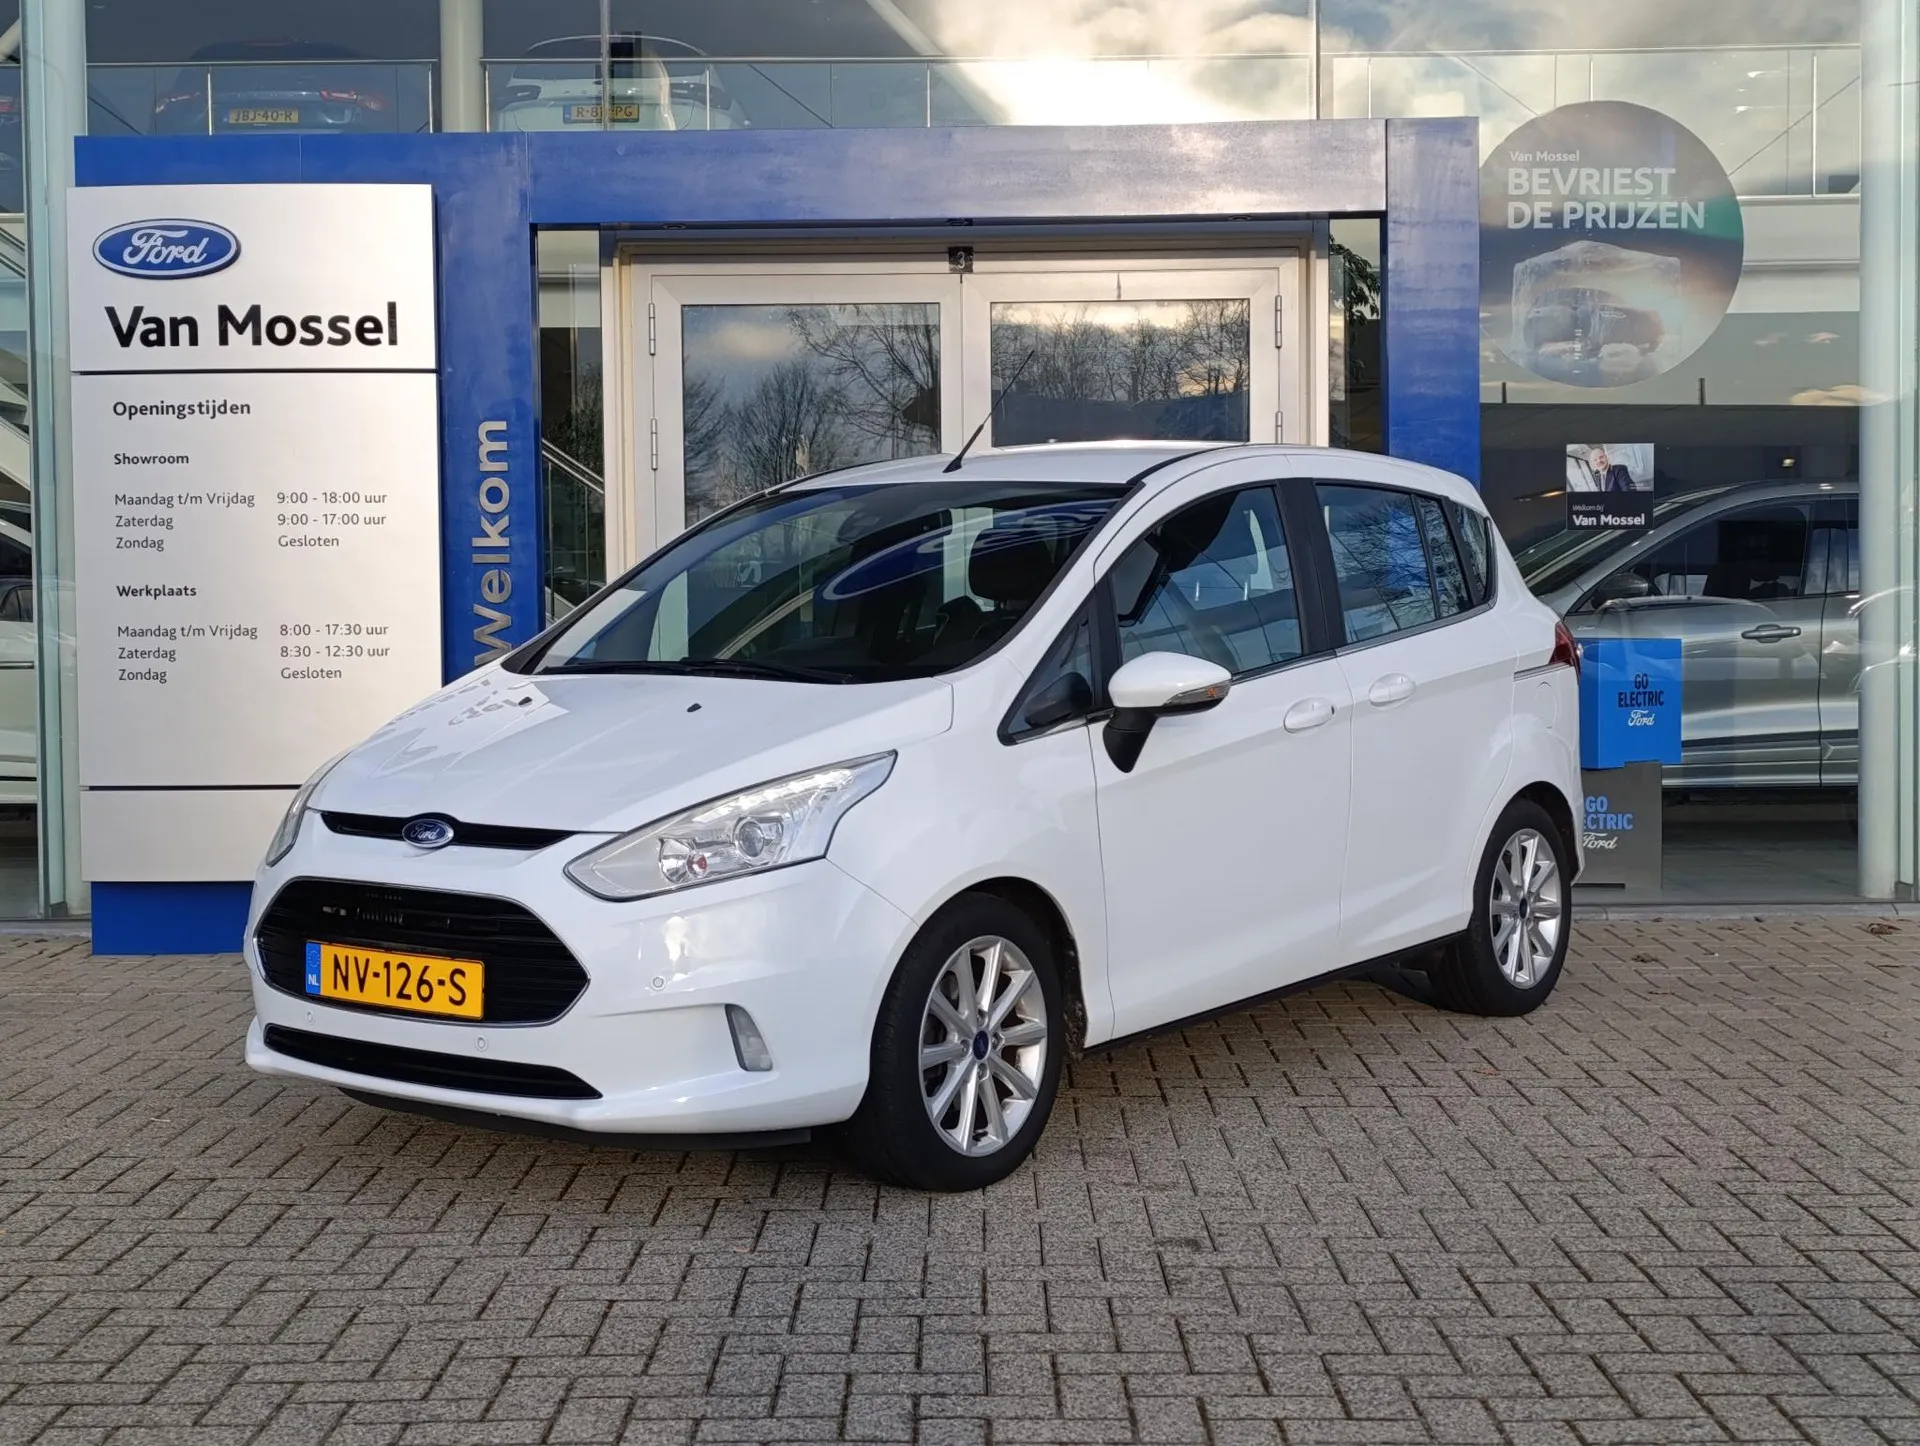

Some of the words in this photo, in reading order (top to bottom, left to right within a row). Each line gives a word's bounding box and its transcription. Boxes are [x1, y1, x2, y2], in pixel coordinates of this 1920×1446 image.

[1509, 151, 1533, 162] Van
[1535, 150, 1580, 162] Mossel
[1507, 167, 1676, 195] BEVRIEST
[1507, 201, 1554, 229] DE
[1563, 201, 1705, 229] PRIJZEN
[122, 226, 210, 265] Ford
[957, 250, 966, 269] 3
[104, 305, 199, 349] Van
[217, 301, 398, 347] Mossel
[112, 399, 251, 420] Openingstijden
[113, 452, 190, 466] Showroom
[114, 492, 175, 508] Maandag
[177, 492, 203, 506] t/m
[205, 491, 256, 508] Vrijdag
[276, 491, 309, 505] 9:00
[321, 491, 361, 504] 18:00
[364, 494, 388, 504] uur
[114, 514, 174, 530] Zaterdag
[276, 513, 309, 526] 9:00
[321, 512, 360, 526] 17:00
[363, 515, 387, 526] uur
[1572, 514, 1597, 526] Van
[1600, 513, 1646, 526] Mossel
[115, 536, 165, 552] Zondag
[277, 533, 340, 548] Gesloten
[471, 420, 513, 668] Welkom
[116, 584, 197, 601] Werkplaats
[117, 625, 178, 641] Maandag
[180, 624, 206, 638] t/m
[209, 624, 259, 641] Vrijdag
[279, 623, 312, 637] 8:00
[324, 623, 363, 636] 17:30
[366, 626, 389, 636] uur
[117, 646, 177, 663] Zaterdag
[279, 645, 312, 658] 8:30
[324, 644, 364, 658] 12:30
[367, 647, 391, 658] uur
[118, 667, 168, 684] Zondag
[280, 666, 342, 680] Gesloten
[1634, 673, 1649, 690] GO
[1617, 690, 1665, 708] ELECTRIC
[1628, 709, 1655, 726] Ford
[1585, 796, 1608, 813] GO
[1583, 813, 1634, 830] CTRIC
[411, 822, 441, 840] Ford
[308, 973, 319, 987] NL
[333, 953, 467, 1006] NV-126-S
